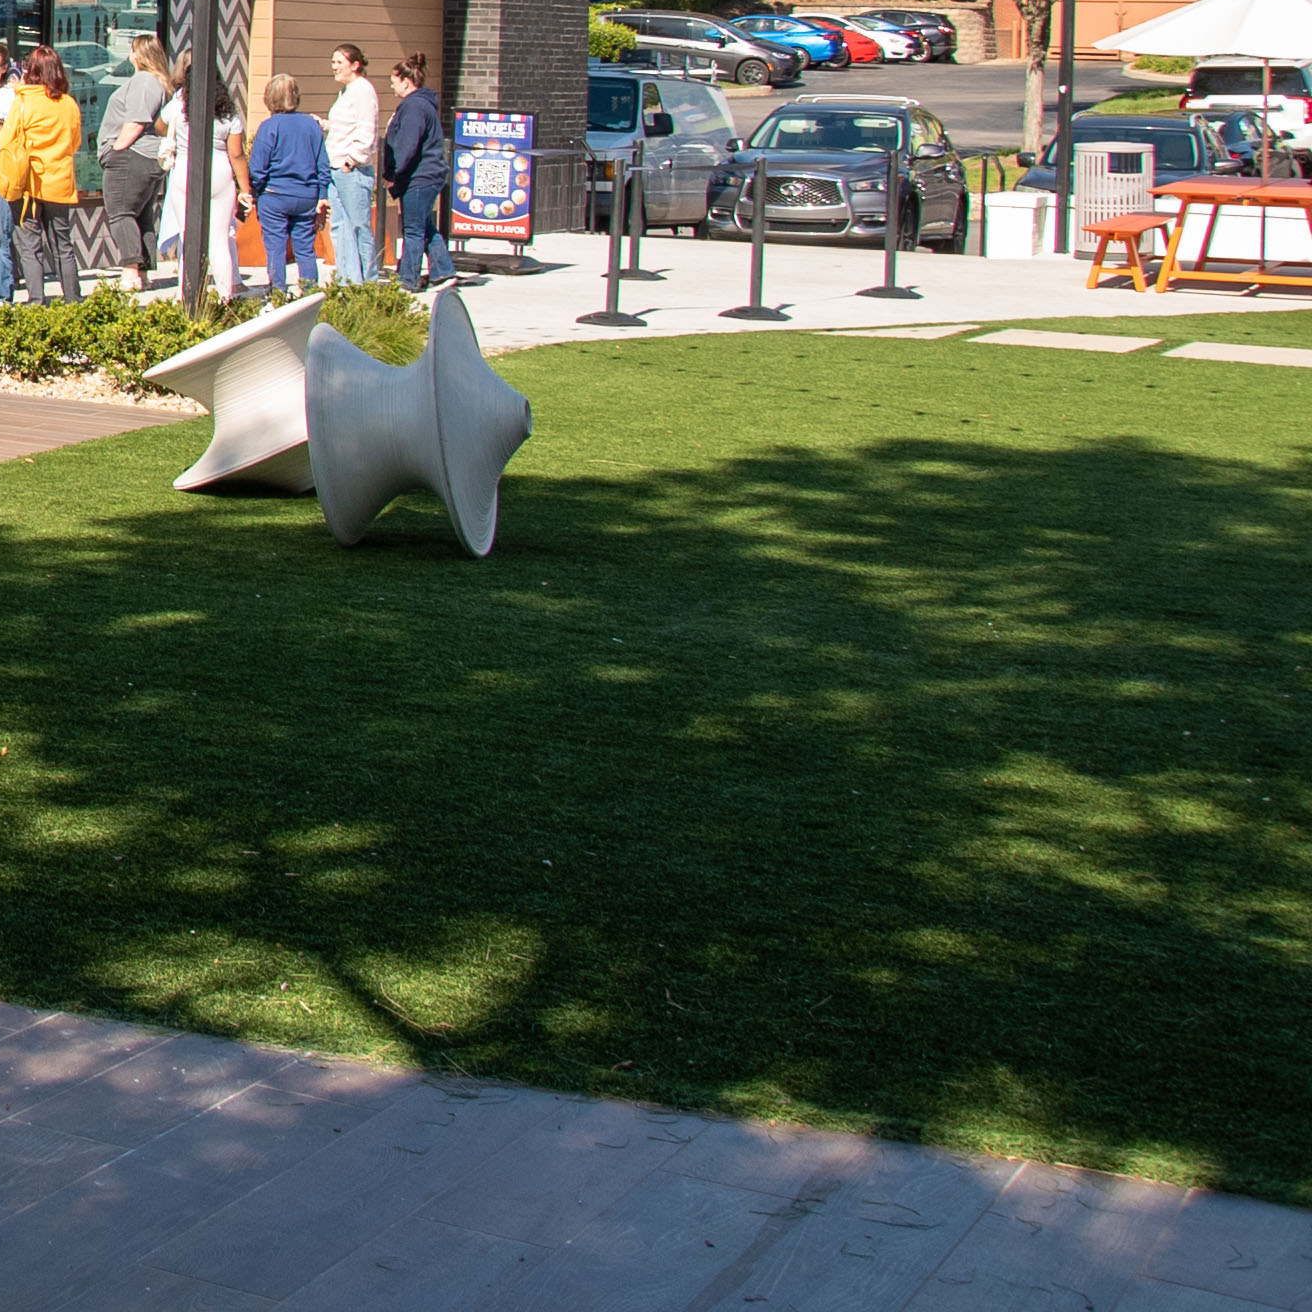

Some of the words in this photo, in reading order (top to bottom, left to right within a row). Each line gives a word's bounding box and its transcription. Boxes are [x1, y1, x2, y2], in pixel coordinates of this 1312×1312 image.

[462, 120, 526, 136] HANDEL'S
[454, 222, 472, 231] PICK
[473, 223, 495, 233] YOUR
[496, 225, 526, 235] FLAVOR
